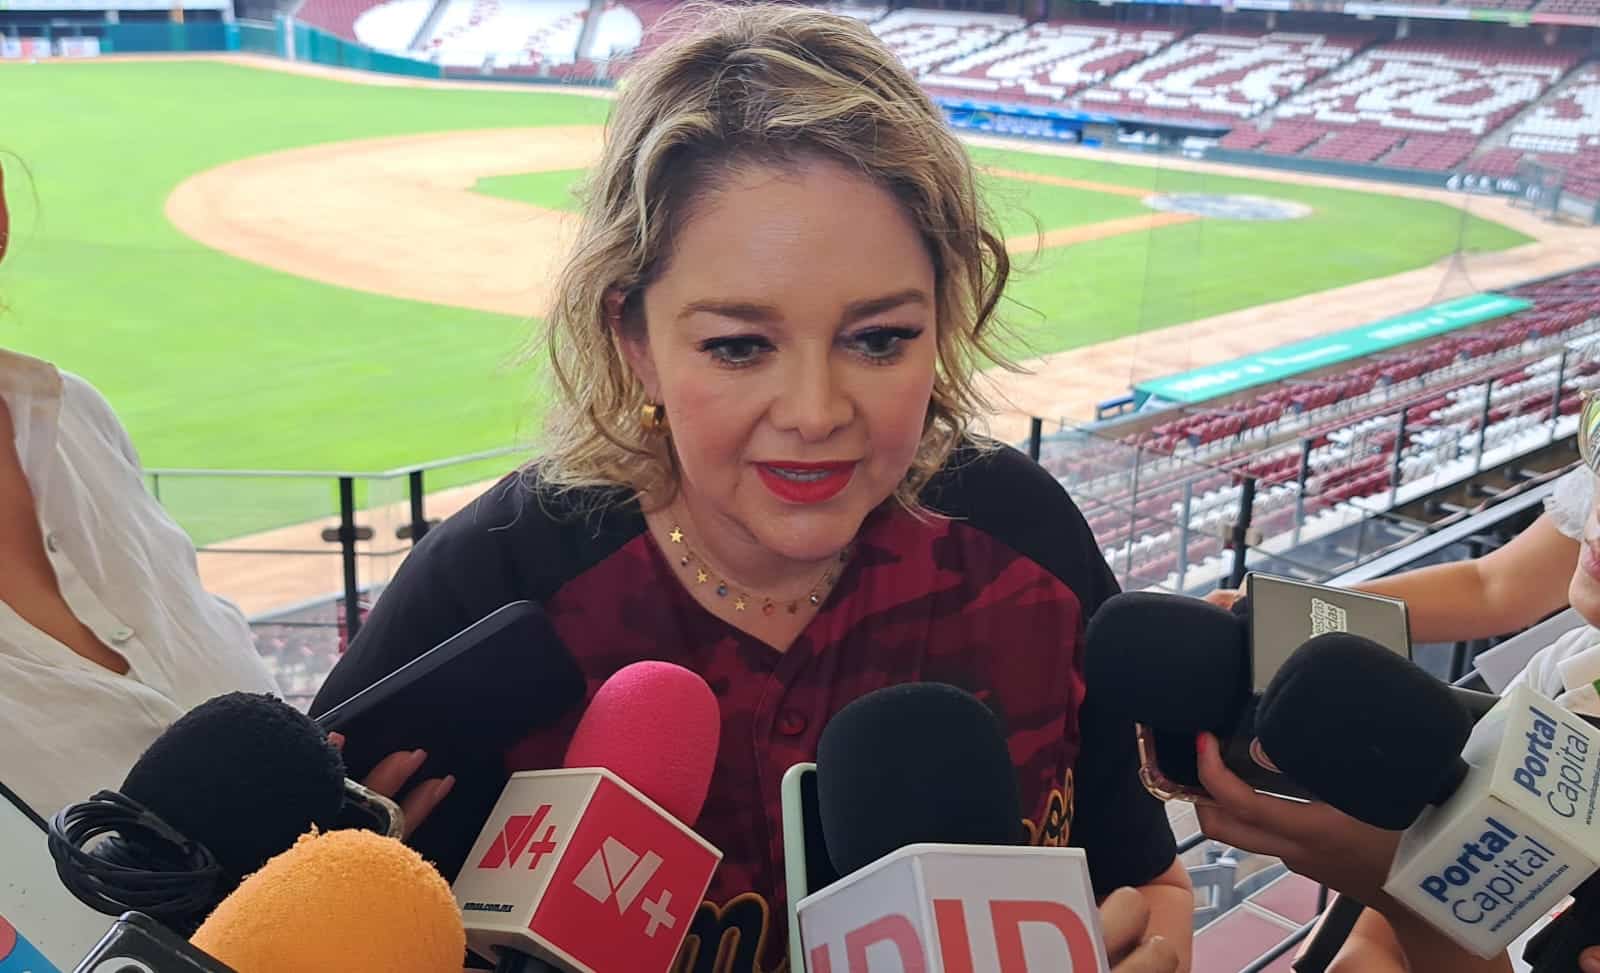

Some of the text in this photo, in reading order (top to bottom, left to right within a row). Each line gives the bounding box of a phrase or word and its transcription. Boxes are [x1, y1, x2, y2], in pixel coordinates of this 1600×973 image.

[1513, 706, 1558, 797] Portal
[1547, 721, 1591, 819] Capital
[1419, 816, 1519, 903] Portal
[1452, 835, 1556, 924] Capital
